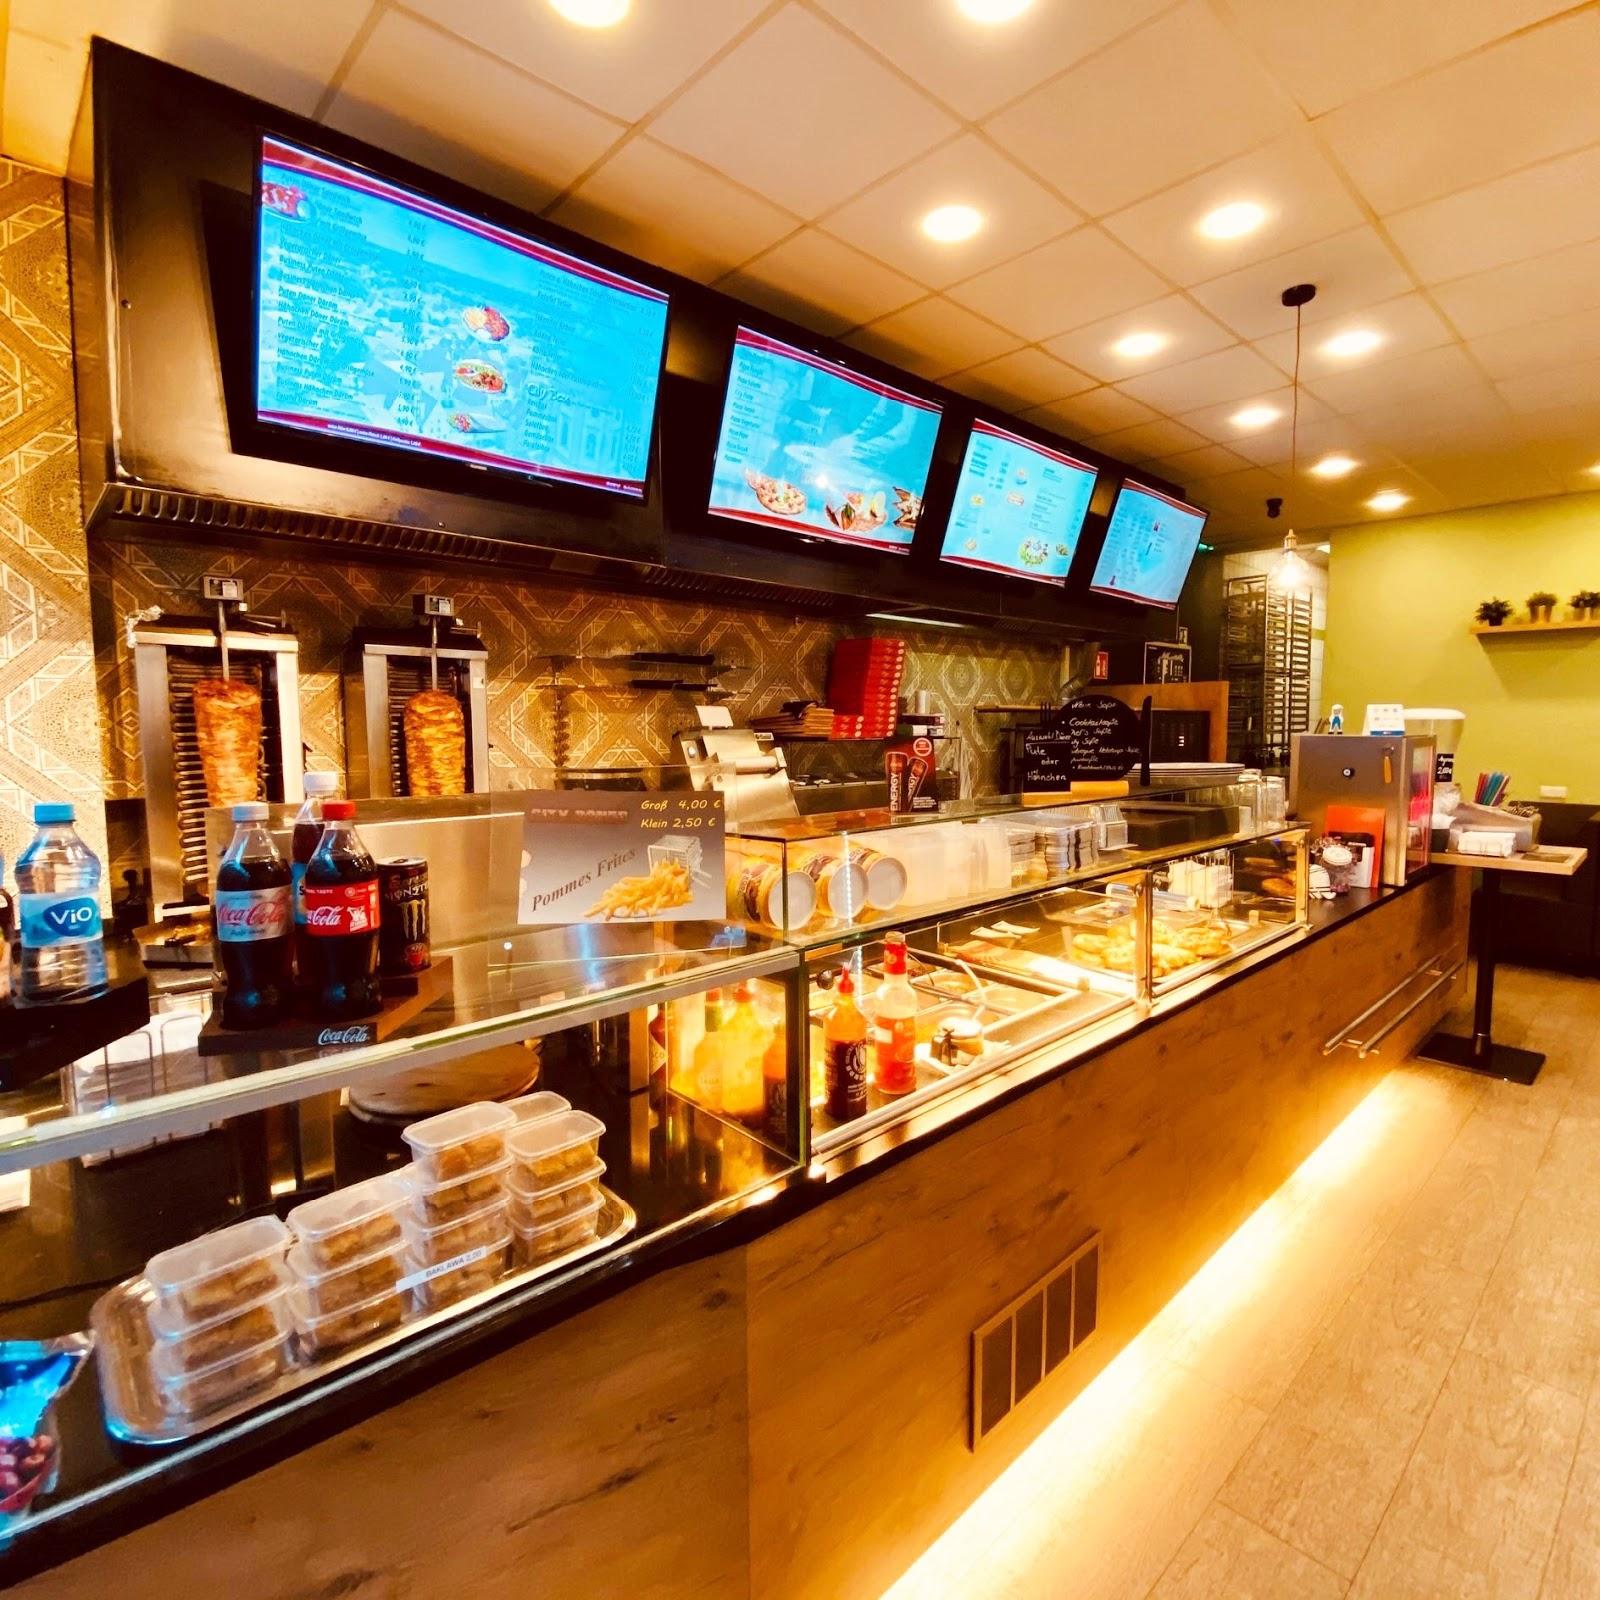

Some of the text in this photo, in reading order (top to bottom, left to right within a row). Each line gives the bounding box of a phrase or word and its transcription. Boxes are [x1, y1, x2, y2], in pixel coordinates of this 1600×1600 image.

[1025, 743, 1047, 756] Pute
[1041, 756, 1060, 766] oder
[890, 772, 899, 811] ENERGY
[641, 800, 721, 811] Groß 4,00 €
[640, 817, 716, 829] Klein 2,50 €
[532, 849, 636, 912] Pommes Frites
[318, 1024, 370, 1046] Coca-Cola
